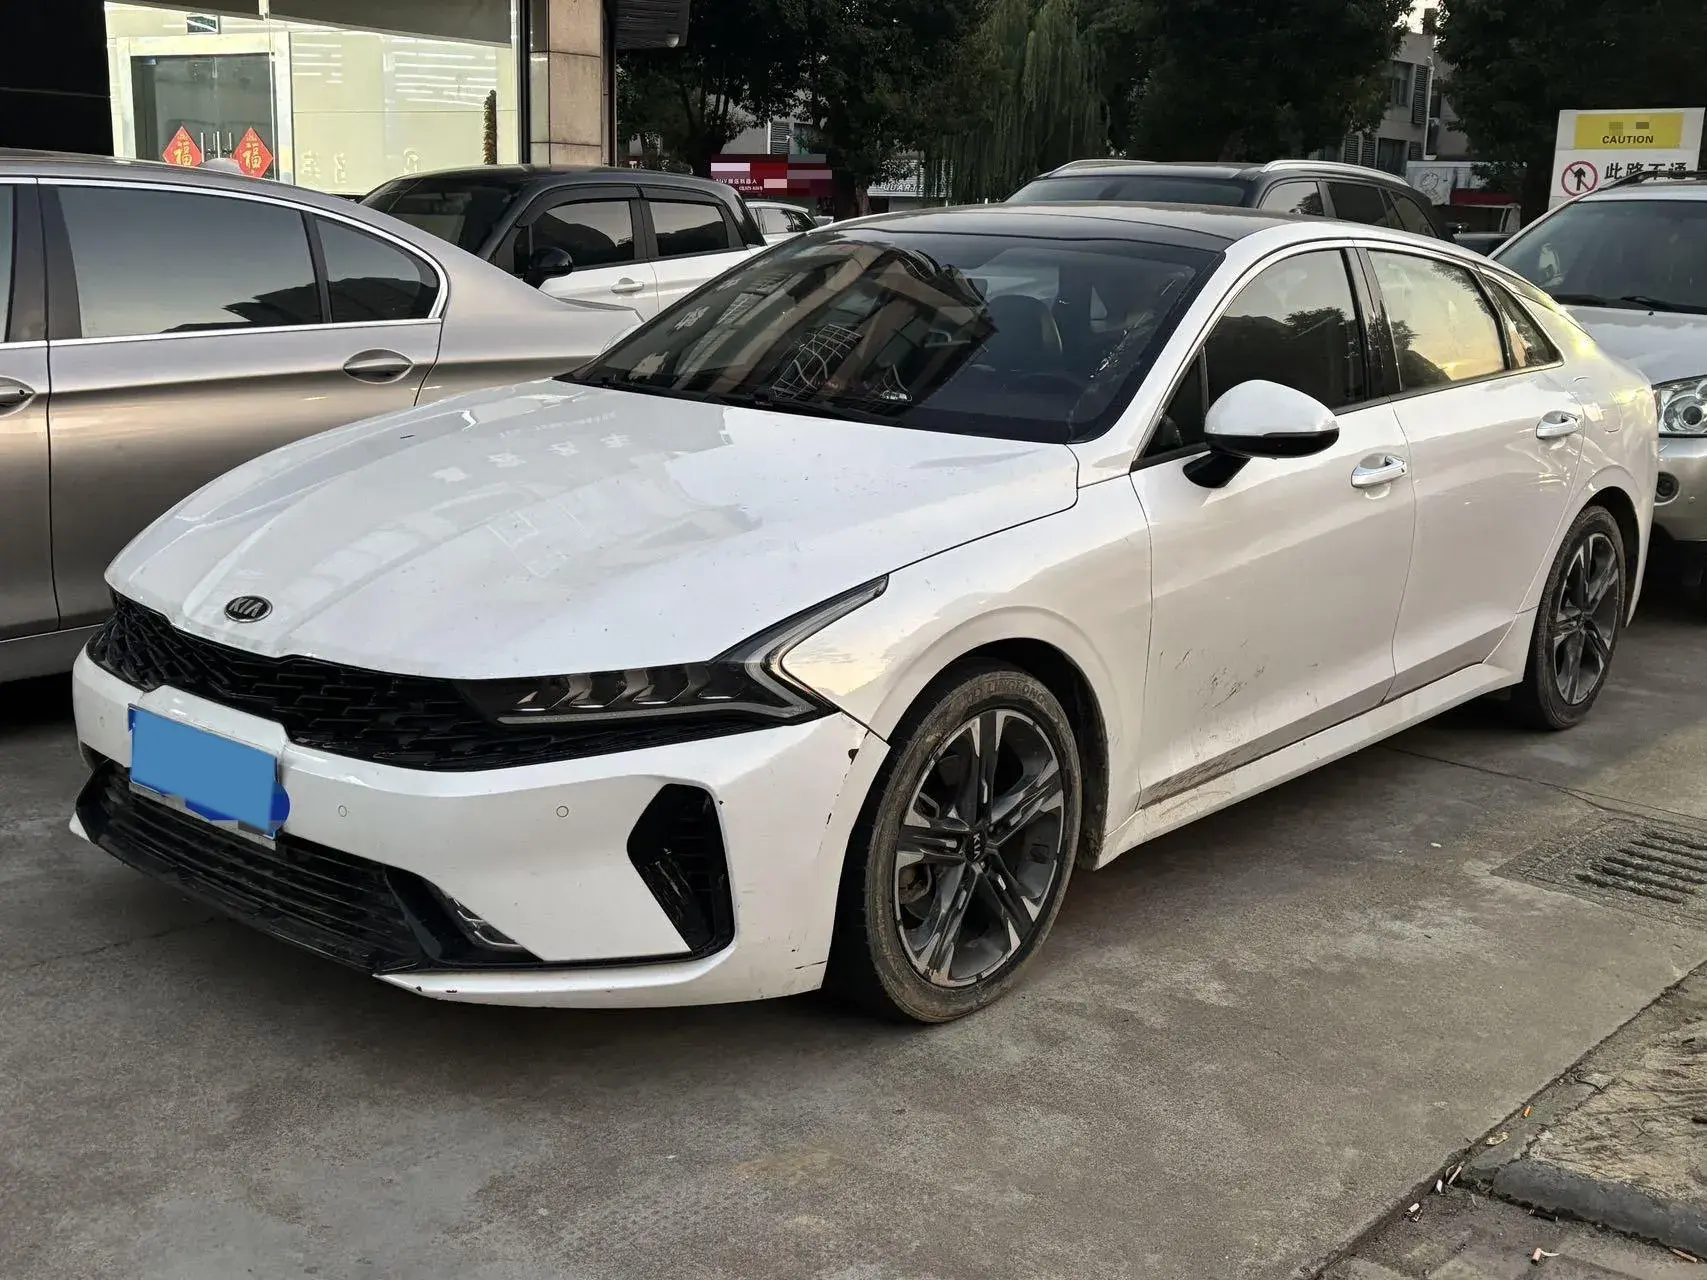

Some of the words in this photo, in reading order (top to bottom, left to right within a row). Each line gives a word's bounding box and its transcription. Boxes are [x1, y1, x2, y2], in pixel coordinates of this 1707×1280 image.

[1602, 135, 1654, 144] CAUTION
[173, 141, 192, 166] 福
[243, 142, 263, 169] 福
[228, 598, 264, 618] KIA
